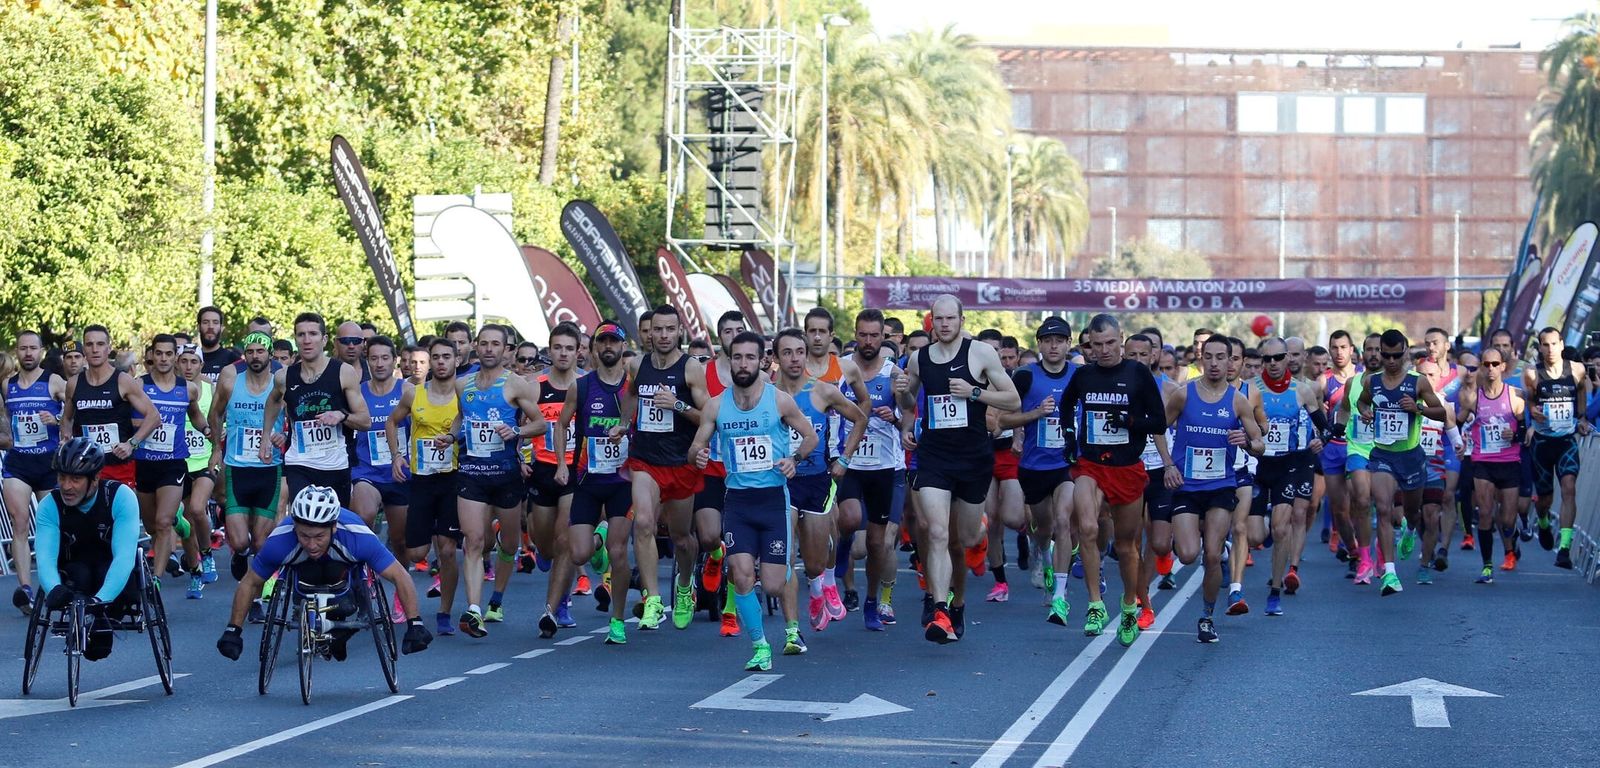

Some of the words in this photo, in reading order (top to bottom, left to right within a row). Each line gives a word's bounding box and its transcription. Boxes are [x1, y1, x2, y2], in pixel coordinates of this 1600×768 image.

[1074, 281, 1091, 292] 35
[1095, 281, 1146, 293] MEDIA
[1229, 281, 1266, 292] 2019
[1336, 284, 1406, 298] IMDECO
[1104, 292, 1244, 309] CÓRDOBA
[76, 399, 113, 408] GRANADA
[1085, 392, 1129, 403] GRANADA
[234, 401, 264, 411] nerja
[941, 403, 957, 418] 19
[649, 408, 663, 422] 50
[1554, 409, 1570, 420] 113
[24, 422, 39, 434] 39
[722, 418, 759, 430] nerja
[1383, 420, 1402, 433] 157
[96, 432, 111, 444] 48
[152, 430, 166, 443] 40
[308, 427, 332, 443] 100
[479, 429, 494, 443] 67
[1267, 431, 1281, 443] 63
[185, 436, 204, 448] 363
[430, 448, 445, 461] 78
[604, 445, 620, 459] 98
[741, 444, 767, 461] 149
[1205, 457, 1213, 470] 2
